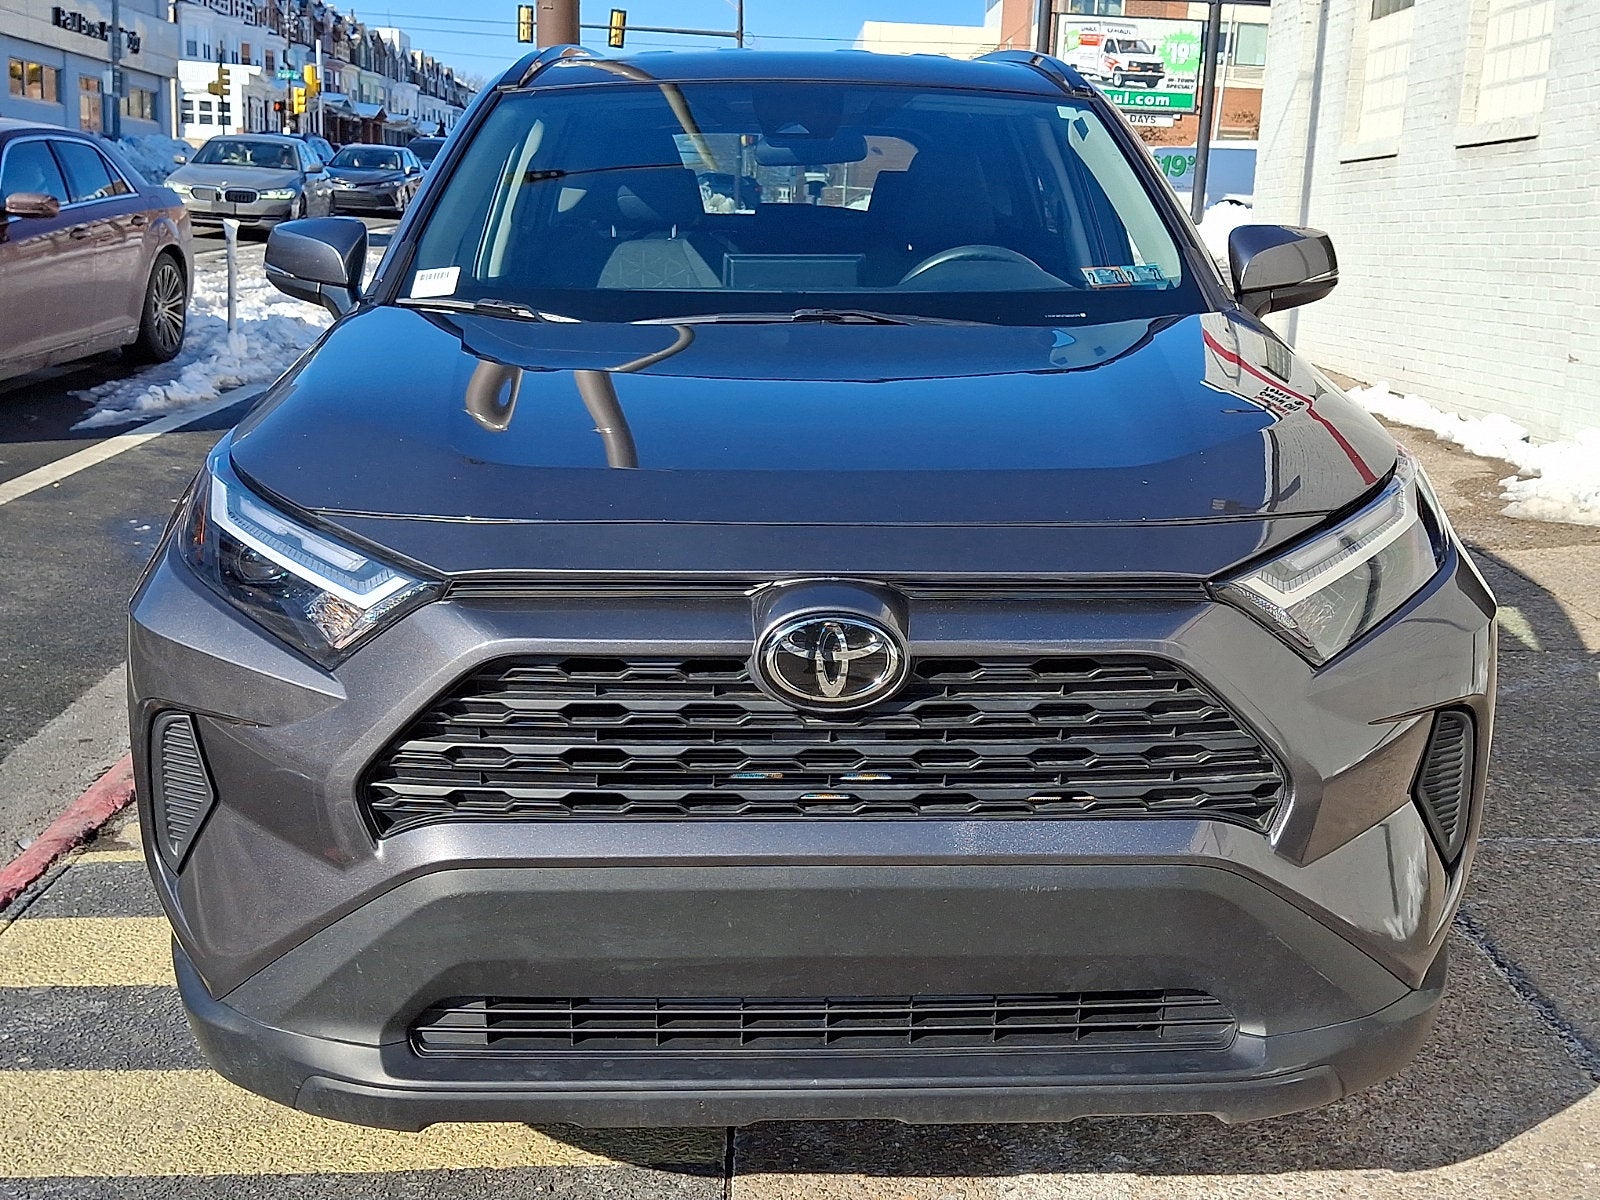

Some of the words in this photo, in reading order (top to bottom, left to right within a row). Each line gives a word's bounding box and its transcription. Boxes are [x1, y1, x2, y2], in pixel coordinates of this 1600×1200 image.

[1129, 114, 1157, 124] DAYS
[1088, 272, 1099, 284] 2
[1127, 270, 1138, 283] 2
